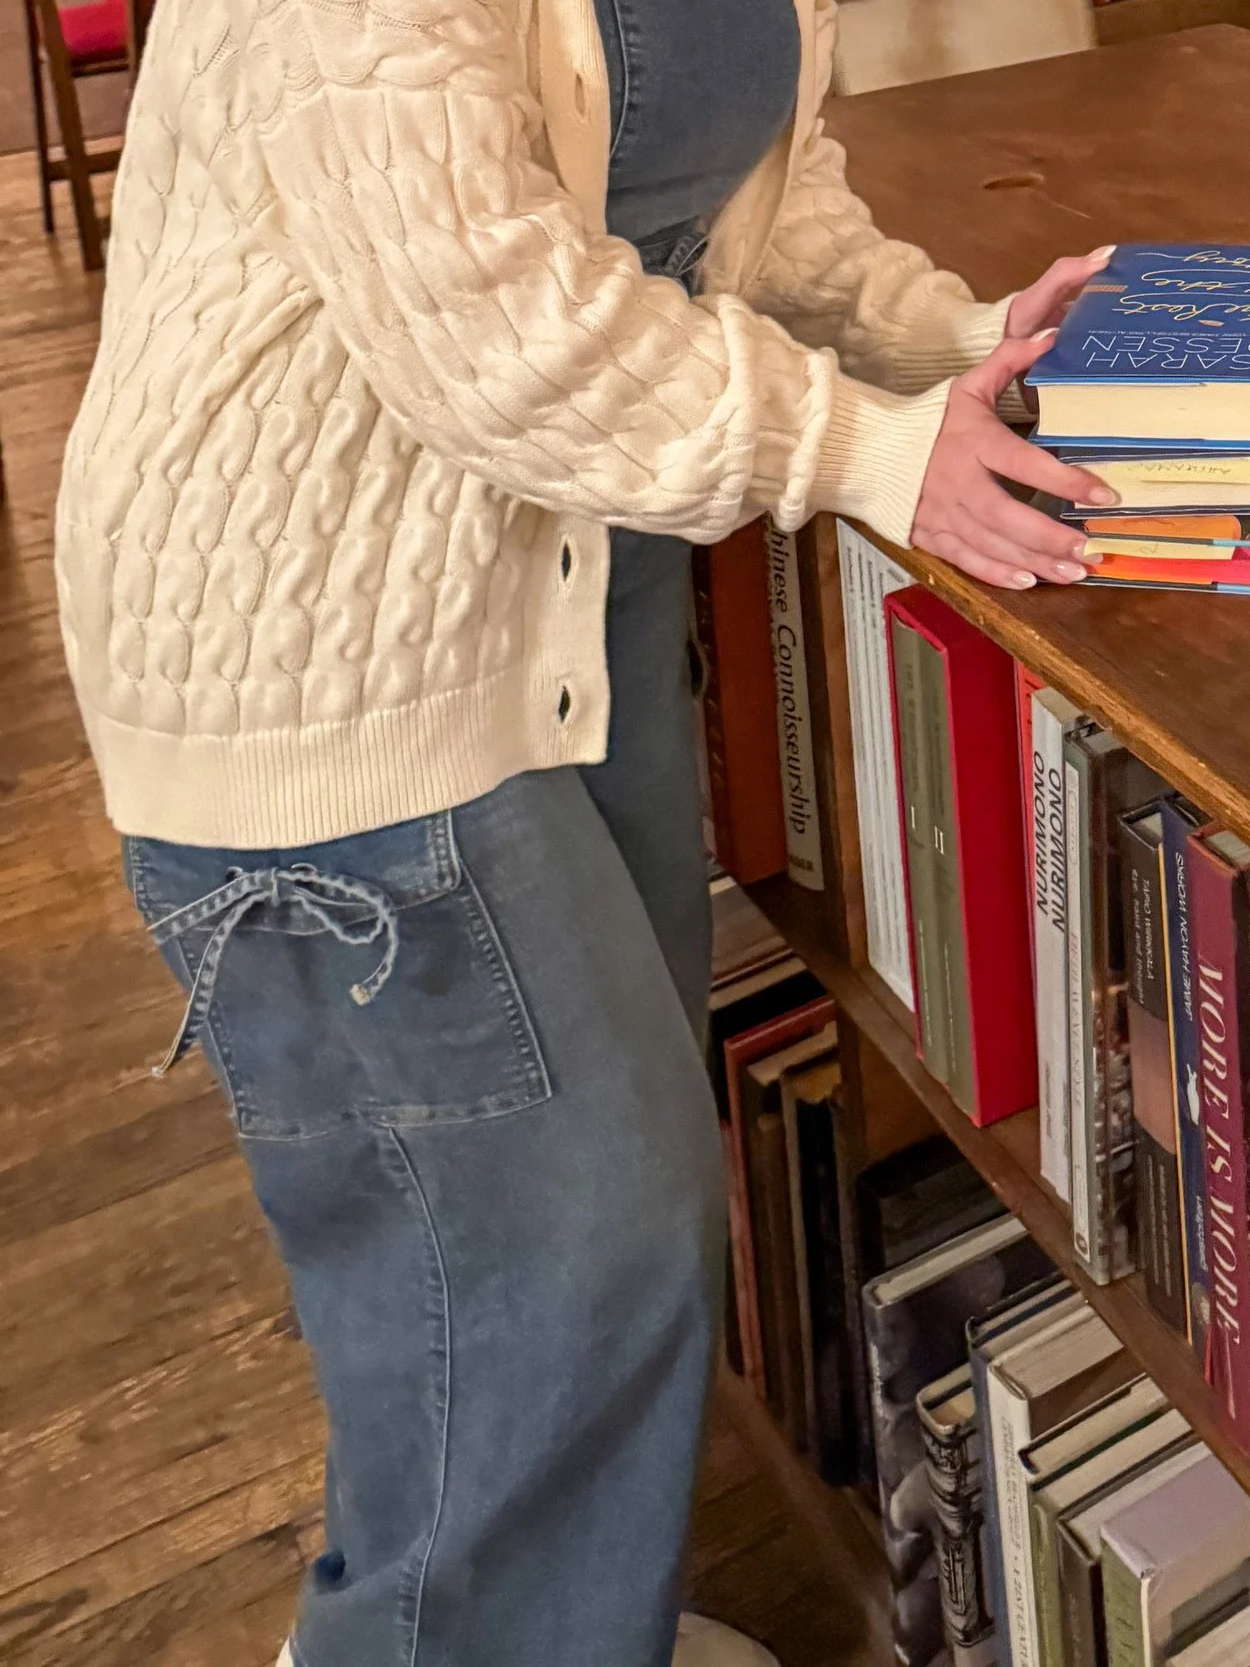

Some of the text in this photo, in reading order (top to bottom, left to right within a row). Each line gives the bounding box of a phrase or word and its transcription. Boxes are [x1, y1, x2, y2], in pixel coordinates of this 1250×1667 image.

[768, 518, 790, 614] hinese
[776, 624, 812, 835] Connoisseurship
[1034, 751, 1049, 916] NURIMONO
[1048, 768, 1066, 934] NURIMONO
[1174, 851, 1194, 1022] JAIME HAYON WORKS
[1198, 962, 1240, 1345] MORE IS MORE
